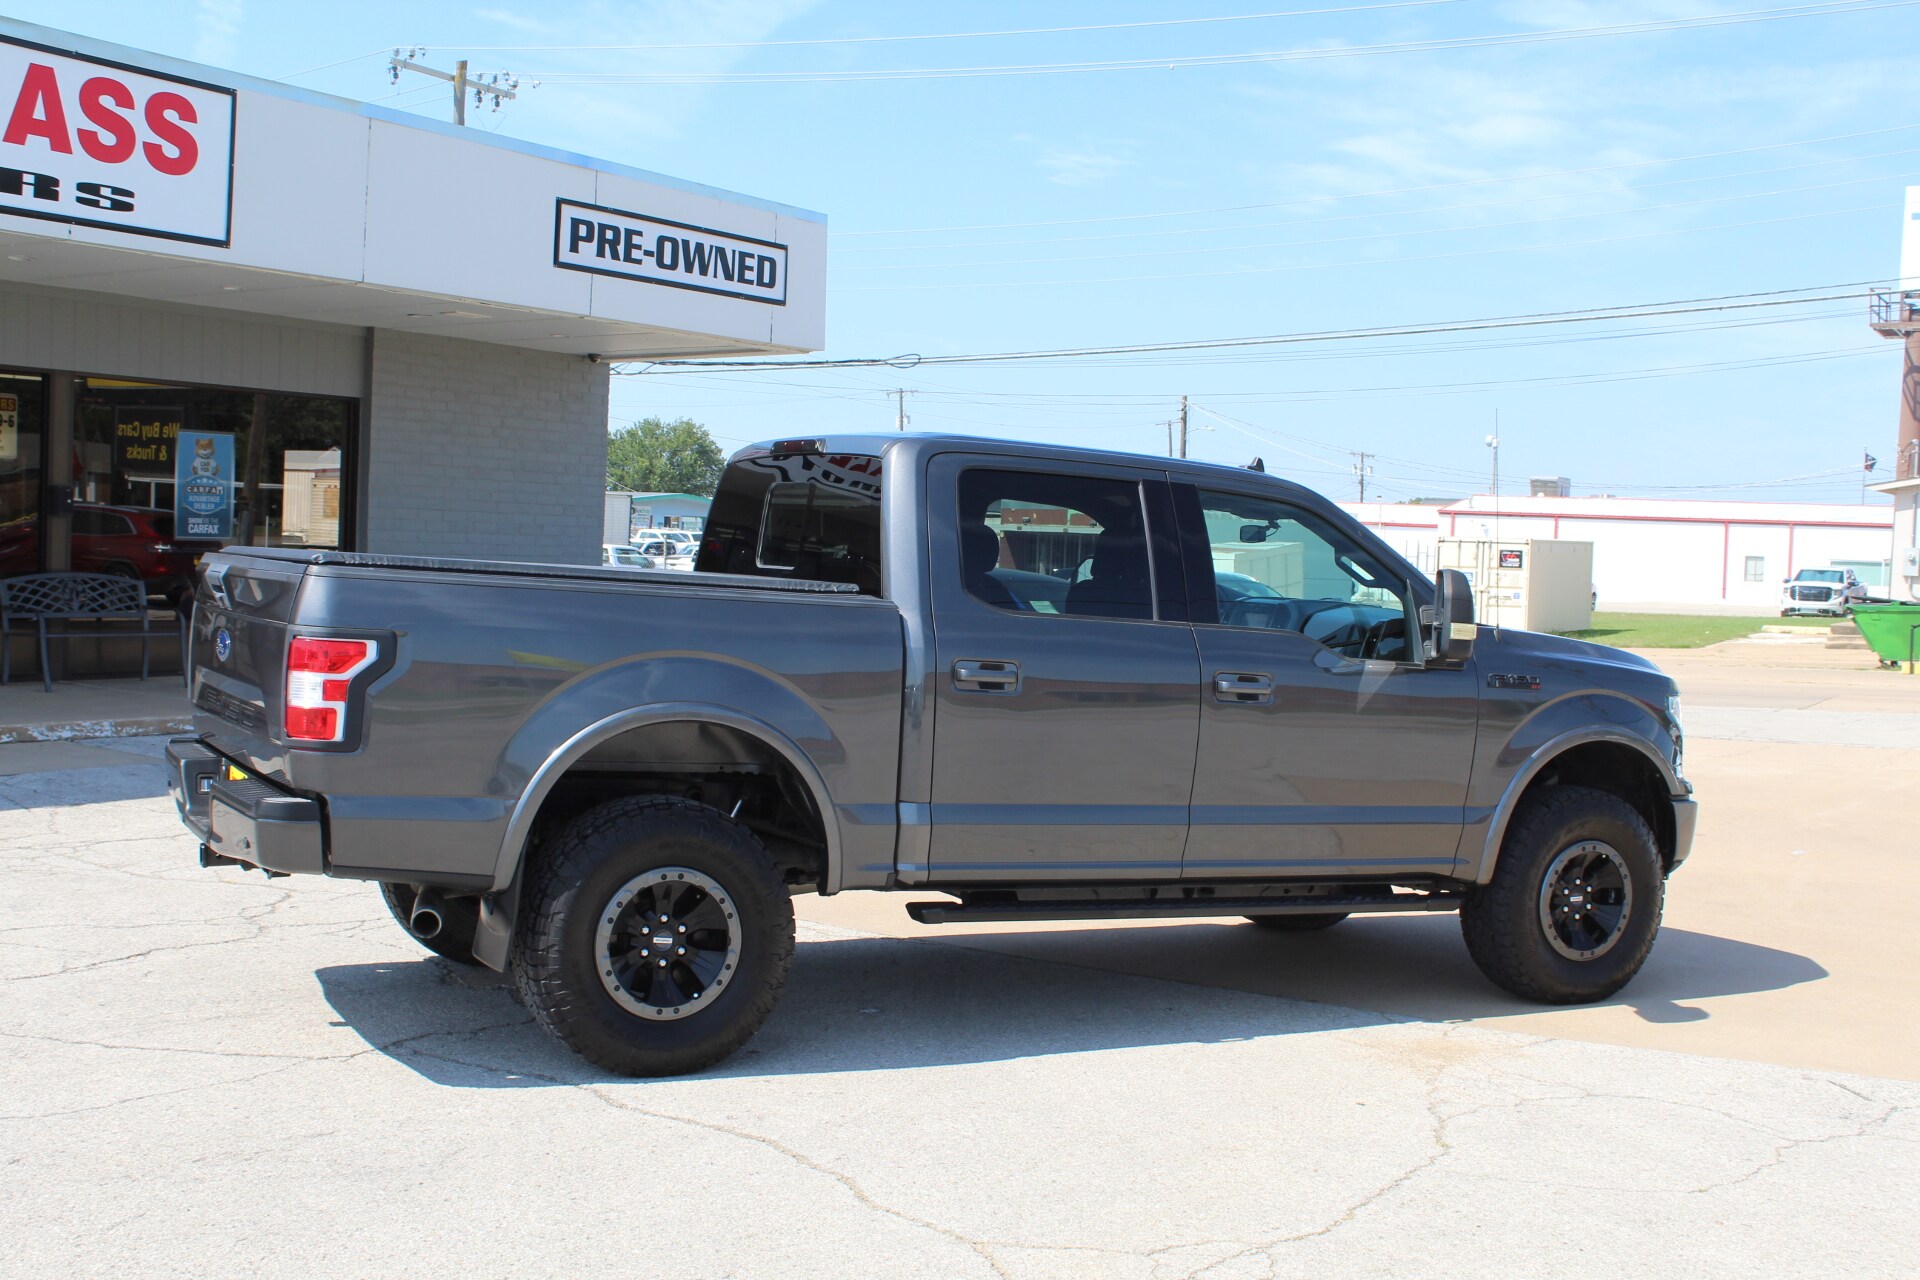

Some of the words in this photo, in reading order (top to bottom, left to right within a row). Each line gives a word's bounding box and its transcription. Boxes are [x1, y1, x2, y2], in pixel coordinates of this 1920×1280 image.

[2, 62, 199, 176] ASS
[0, 166, 135, 212] RS
[568, 216, 777, 289] PRE-OWNED
[188, 524, 219, 534] CARFAX
